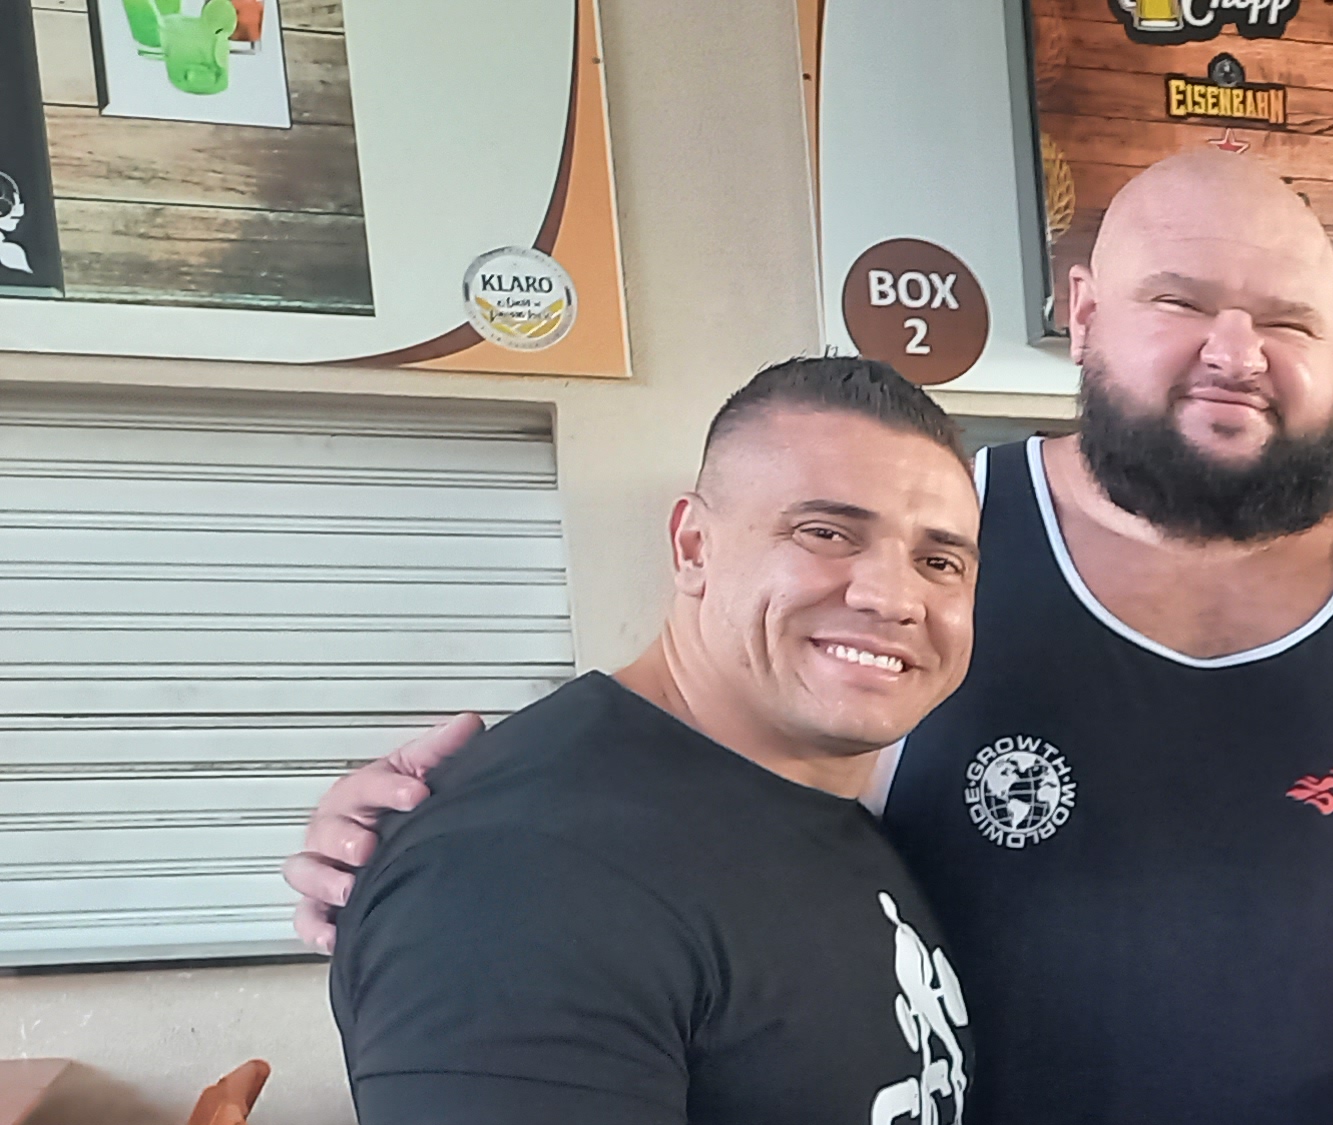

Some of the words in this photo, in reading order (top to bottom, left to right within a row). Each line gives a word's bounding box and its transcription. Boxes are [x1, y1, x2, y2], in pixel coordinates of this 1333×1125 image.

[1168, 79, 1285, 124] EISENBAHN
[481, 274, 553, 294] KLARO
[868, 269, 960, 310] BOX
[903, 317, 931, 355] 2
[965, 734, 1073, 782] GROWTH
[963, 782, 1078, 849] WORLDWIDE
